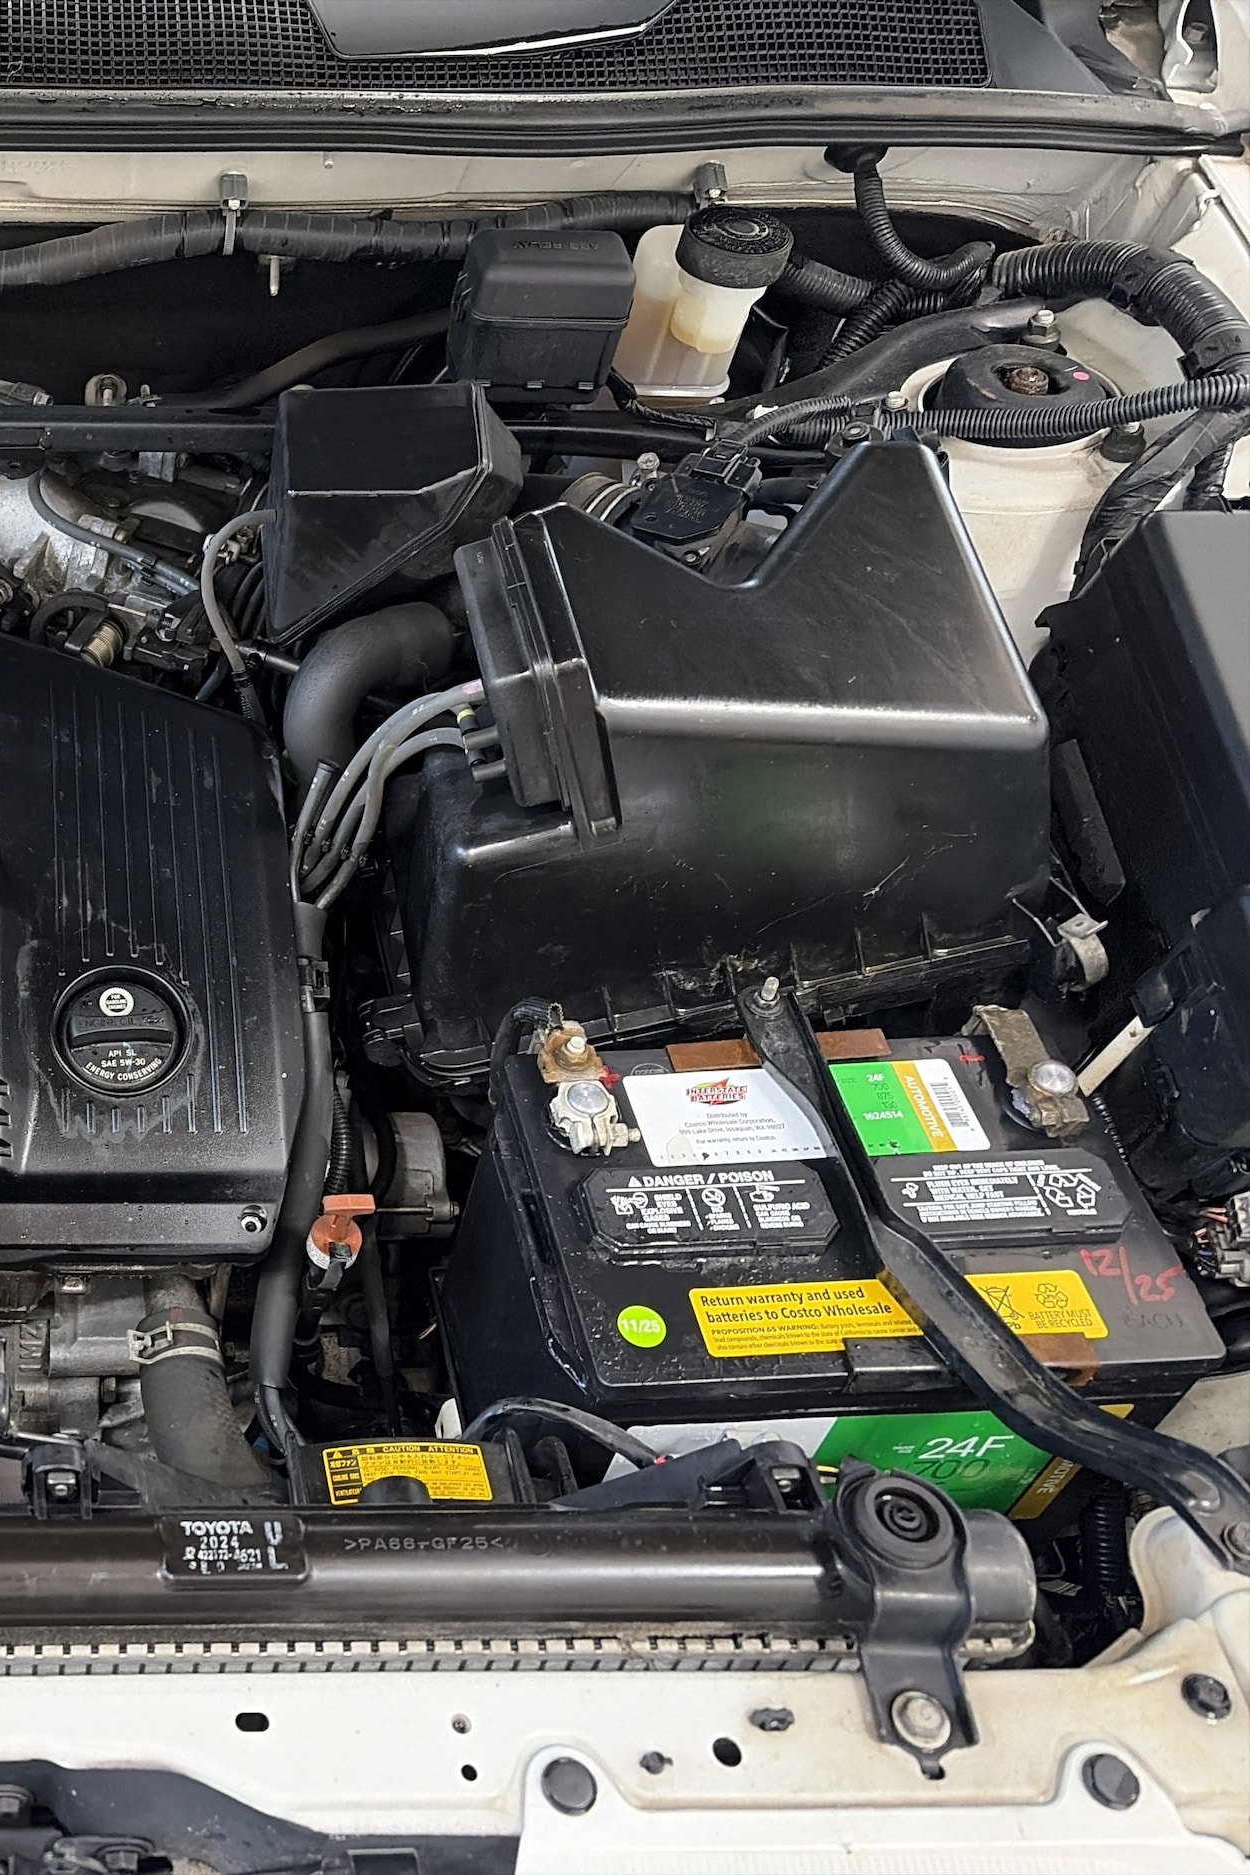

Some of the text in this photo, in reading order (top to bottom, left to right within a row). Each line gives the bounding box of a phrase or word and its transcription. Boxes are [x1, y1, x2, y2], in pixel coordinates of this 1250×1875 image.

[78, 1017, 138, 1029] ENGINE OIL
[108, 1049, 137, 1058] API SL
[85, 1057, 162, 1081] ENERGY CONSERVING
[101, 1058, 146, 1068] SAE 5W-30
[866, 1073, 885, 1082] 24F
[685, 1085, 748, 1096] INTERSTATE
[870, 1082, 889, 1091] 700
[690, 1093, 746, 1102] BATTERIES
[876, 1092, 894, 1100] 875
[903, 1075, 944, 1138] AUTOMOTIVE
[862, 1110, 904, 1121] 1624514
[642, 1173, 705, 1188] DANGER
[718, 1170, 775, 1184] POISON
[700, 1286, 865, 1307] Return warranty and used
[705, 1301, 893, 1323] batteries to Costco Wholesale
[1027, 1308, 1092, 1321] BATTERY MUST
[620, 1318, 661, 1333] 11/25
[711, 1327, 765, 1335] PROPOSITION
[778, 1324, 819, 1332] WARNING:
[1036, 1318, 1093, 1329] BE RECYCLED
[428, 1446, 474, 1454] ATTENTION
[917, 1434, 1015, 1460] 24F
[914, 1459, 991, 1480] 700
[180, 1520, 254, 1536] TOYOTA
[200, 1535, 240, 1549] 2024
